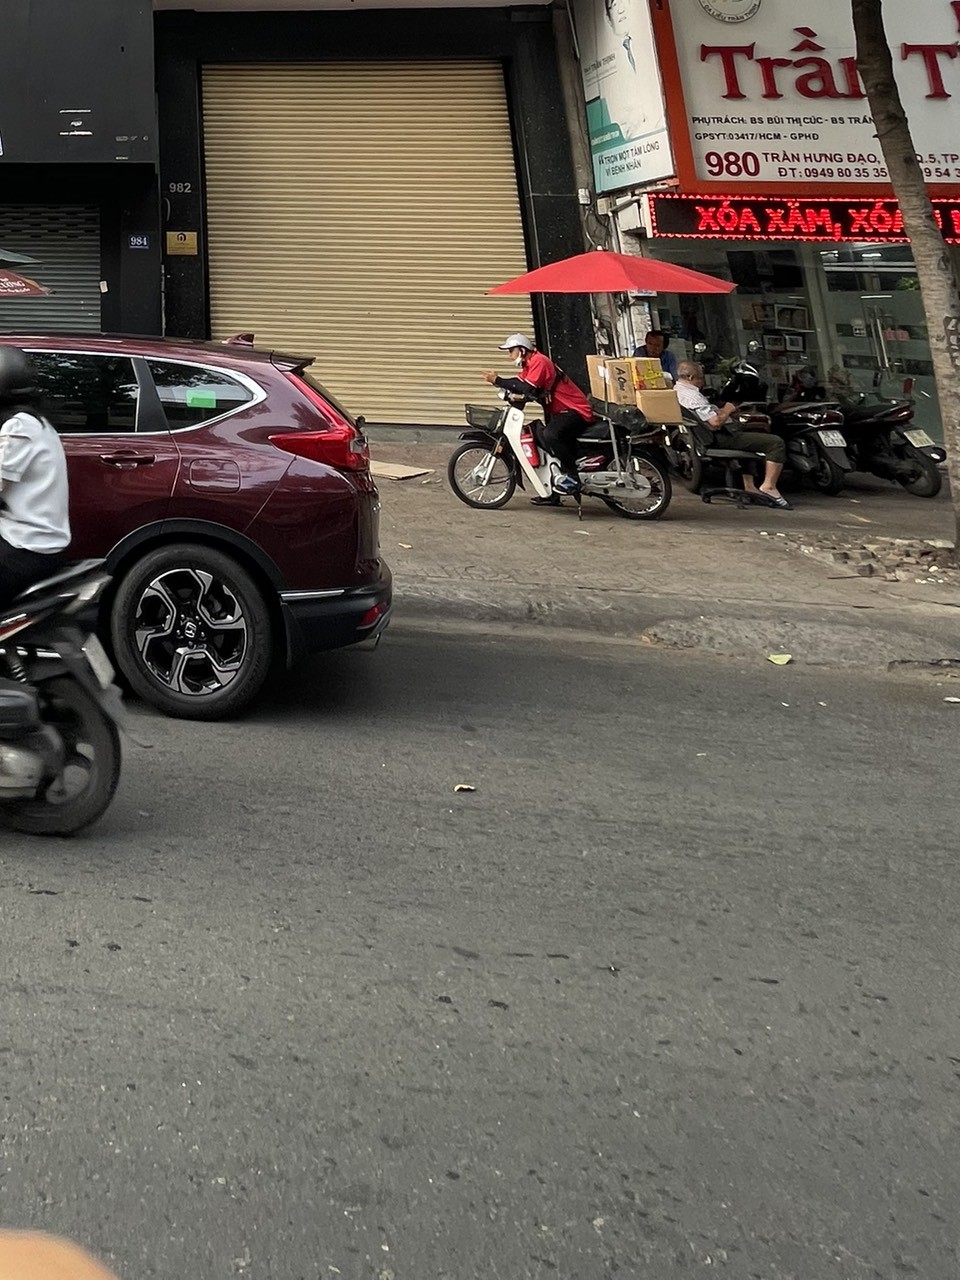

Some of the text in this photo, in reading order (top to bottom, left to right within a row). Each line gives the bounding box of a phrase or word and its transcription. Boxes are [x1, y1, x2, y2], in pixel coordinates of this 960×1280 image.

[705, 151, 761, 177] 980
[762, 150, 801, 163] TRẦN
[804, 152, 843, 163] HƯNG
[847, 152, 881, 166] ĐẠO,
[804, 168, 835, 178] 0949
[855, 168, 869, 178] 35
[873, 168, 888, 178] 35
[936, 169, 951, 178] 54
[169, 182, 192, 193] 982
[695, 201, 761, 232] XÓA
[766, 202, 842, 240] XĂM,
[130, 236, 147, 246] 984
